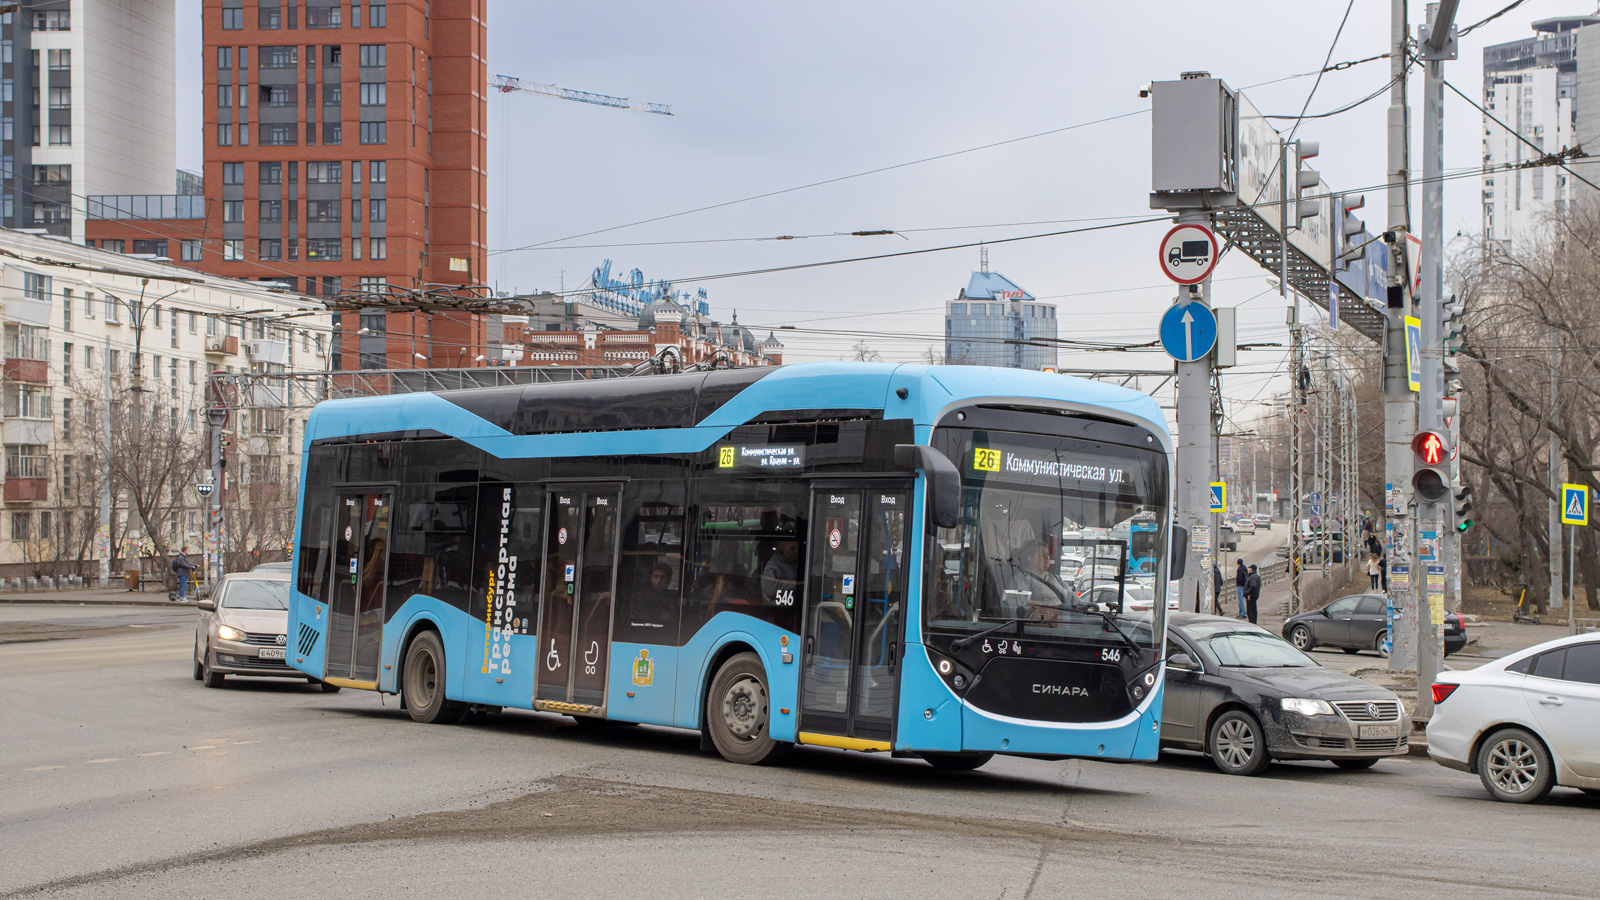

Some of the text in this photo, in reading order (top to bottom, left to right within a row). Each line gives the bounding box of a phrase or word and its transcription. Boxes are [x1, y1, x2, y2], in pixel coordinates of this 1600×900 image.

[721, 449, 732, 465] 26
[978, 450, 1125, 483] 26 Коммунистическая ул.
[560, 496, 571, 505] Вход
[596, 497, 608, 506] Вход
[830, 495, 845, 504] Вход
[881, 494, 896, 505] Вход
[488, 487, 511, 674] Транспортная
[775, 589, 794, 606] 546
[481, 570, 495, 674] Екатеринбург
[501, 555, 517, 675] реформа
[1101, 648, 1120, 662] 546
[1032, 683, 1089, 697] СИНАРА
